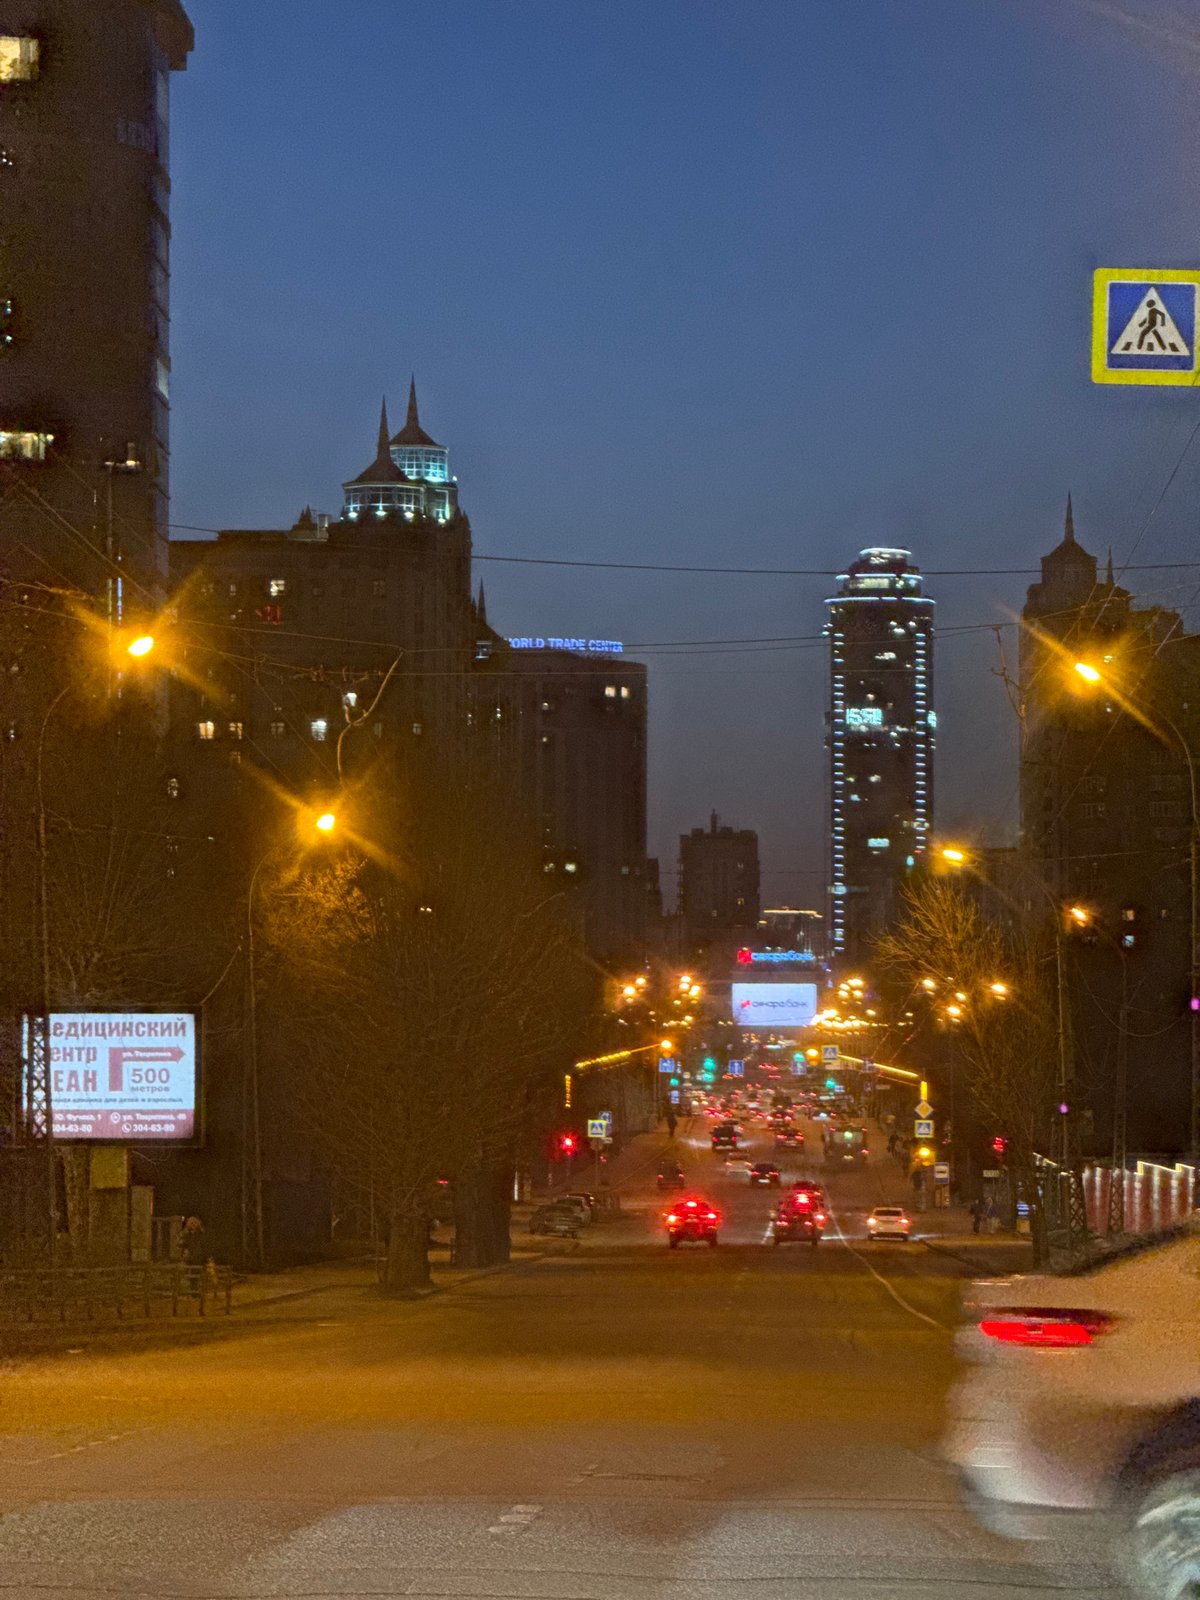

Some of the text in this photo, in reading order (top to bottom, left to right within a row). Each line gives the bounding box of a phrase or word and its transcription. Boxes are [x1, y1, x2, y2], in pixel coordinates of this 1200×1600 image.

[505, 637, 624, 653] ORLD TRADE CENTER
[52, 1017, 187, 1039] едицинский
[50, 1046, 97, 1064] ентр
[53, 1069, 98, 1092] ЕАН
[131, 1067, 170, 1084] 500
[130, 1086, 170, 1094] метров
